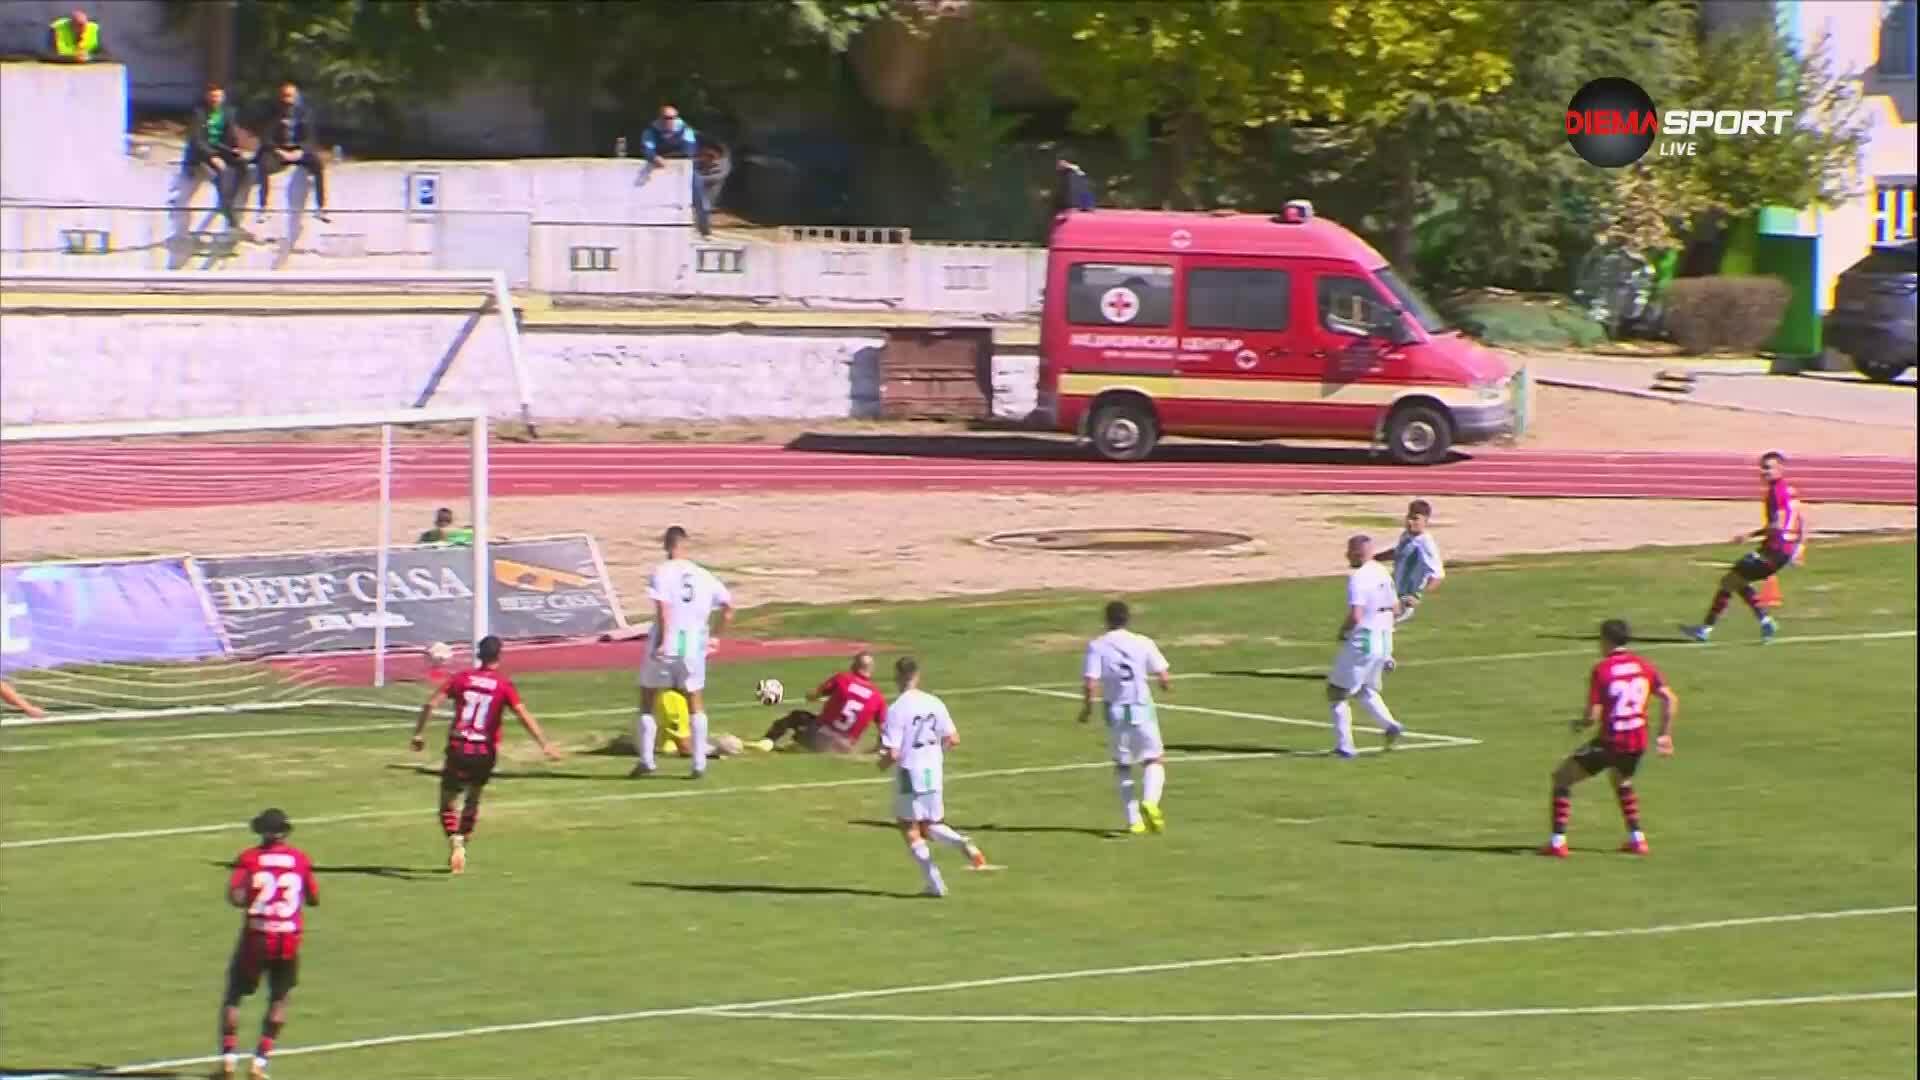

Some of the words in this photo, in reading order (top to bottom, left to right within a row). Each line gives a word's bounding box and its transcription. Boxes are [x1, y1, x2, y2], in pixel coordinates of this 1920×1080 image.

[222, 574, 336, 609] BEEF
[347, 567, 474, 602] CASA
[832, 699, 865, 731] 5
[1608, 676, 1651, 717] 29
[912, 712, 938, 749] 23
[249, 870, 303, 917] 23
